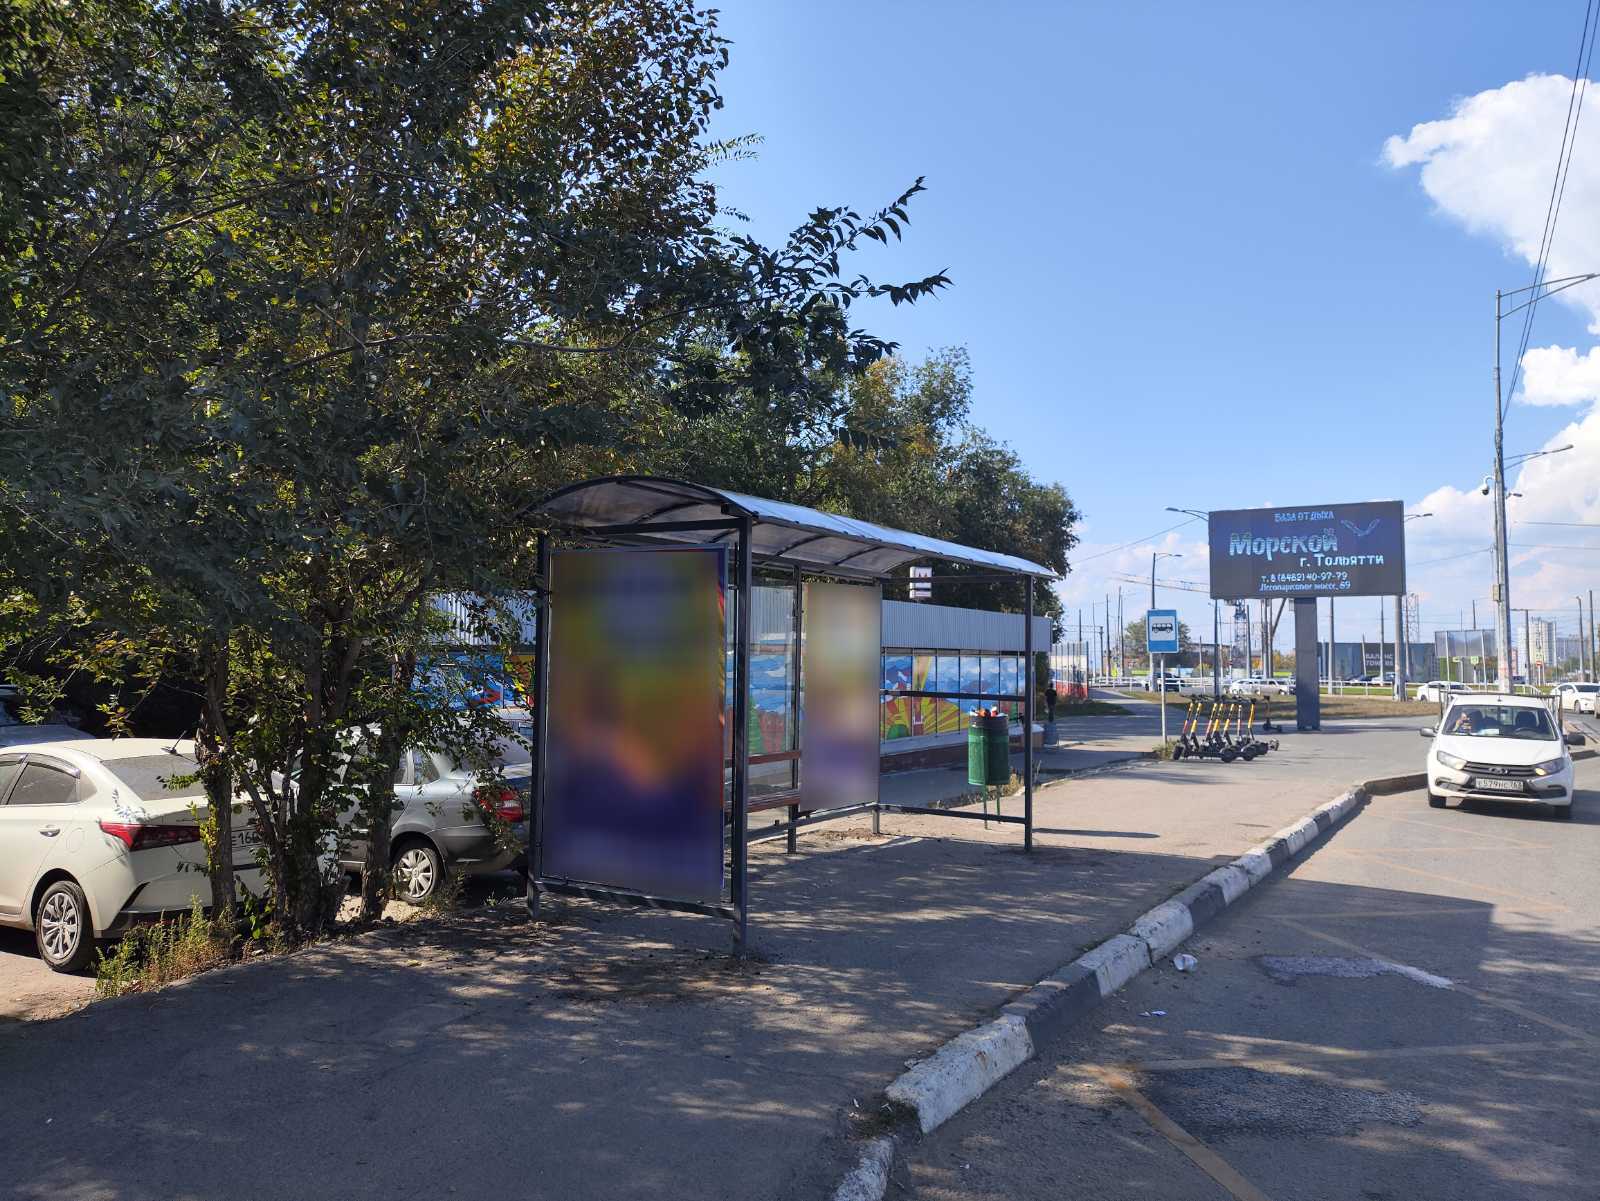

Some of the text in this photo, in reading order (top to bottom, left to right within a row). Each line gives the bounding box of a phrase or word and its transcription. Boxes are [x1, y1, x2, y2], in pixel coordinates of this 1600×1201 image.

[1274, 510, 1335, 523] БАЗА ОТДЫХА
[1229, 527, 1338, 561] Морской
[1299, 553, 1384, 567] г. Тольятти
